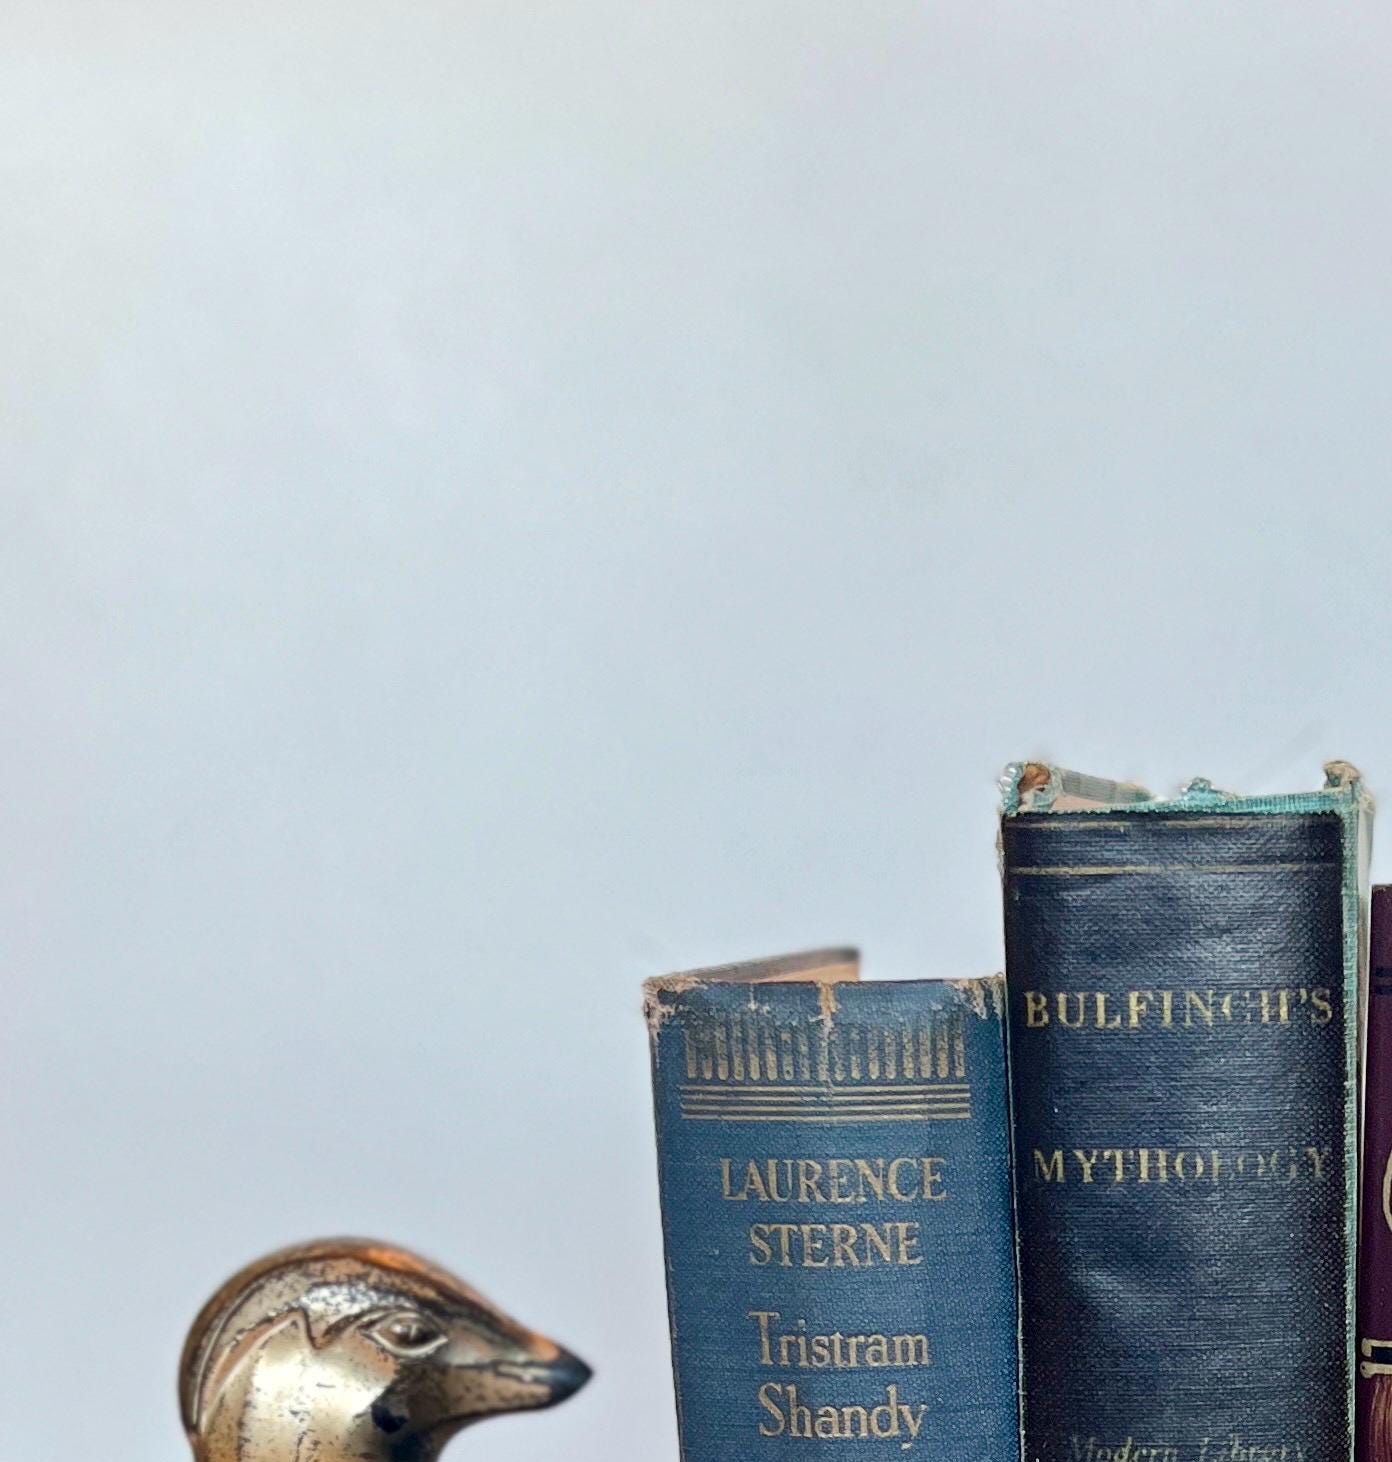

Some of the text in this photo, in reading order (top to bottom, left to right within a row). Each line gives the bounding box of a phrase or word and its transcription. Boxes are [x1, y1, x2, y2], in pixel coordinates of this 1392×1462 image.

[1024, 989, 1333, 1028] BULFINCH'S
[719, 1157, 947, 1203] LAURENCE
[750, 1221, 923, 1267] STERNE
[748, 1311, 929, 1367] Tristram
[757, 1382, 928, 1449] Shandy
